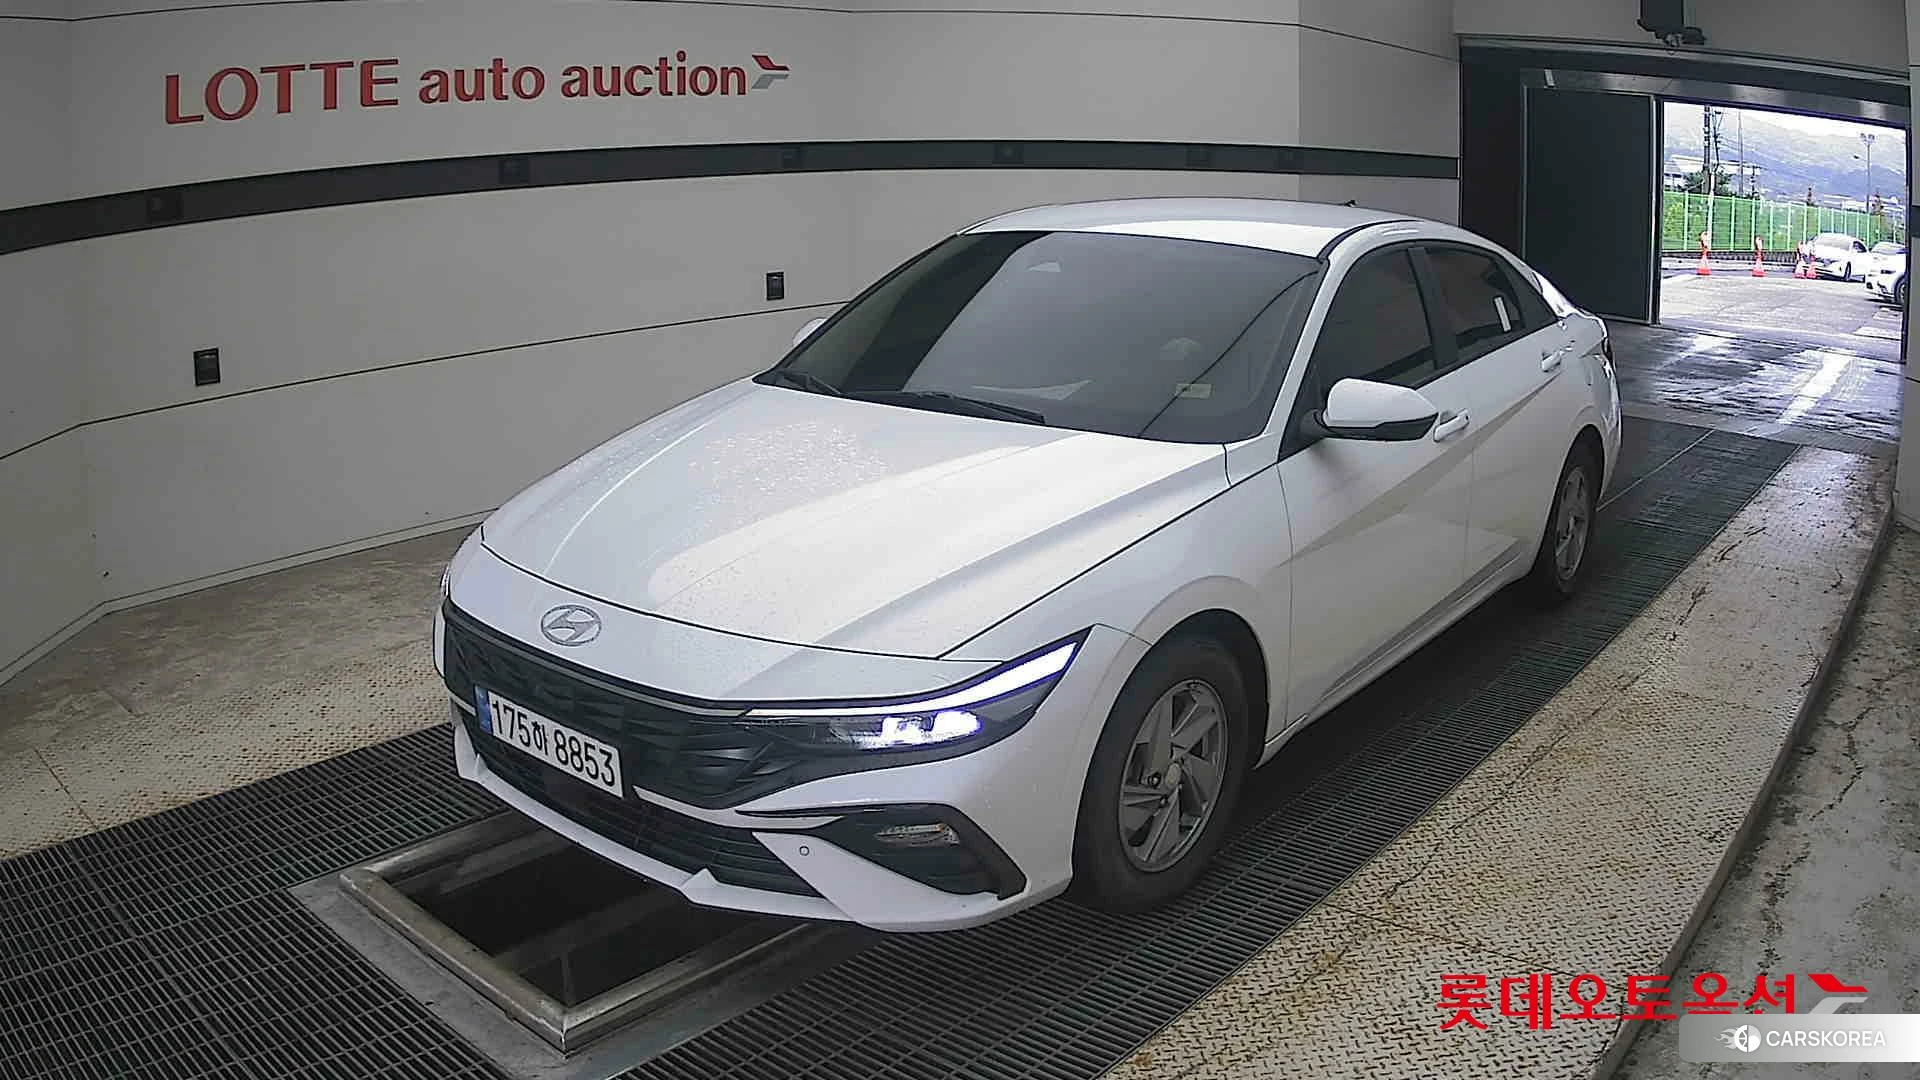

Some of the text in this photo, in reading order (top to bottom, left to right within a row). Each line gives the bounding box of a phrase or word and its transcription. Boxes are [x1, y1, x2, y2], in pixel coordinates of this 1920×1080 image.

[165, 50, 747, 125] LOTTE auto auction
[492, 700, 615, 787] 175하 8853
